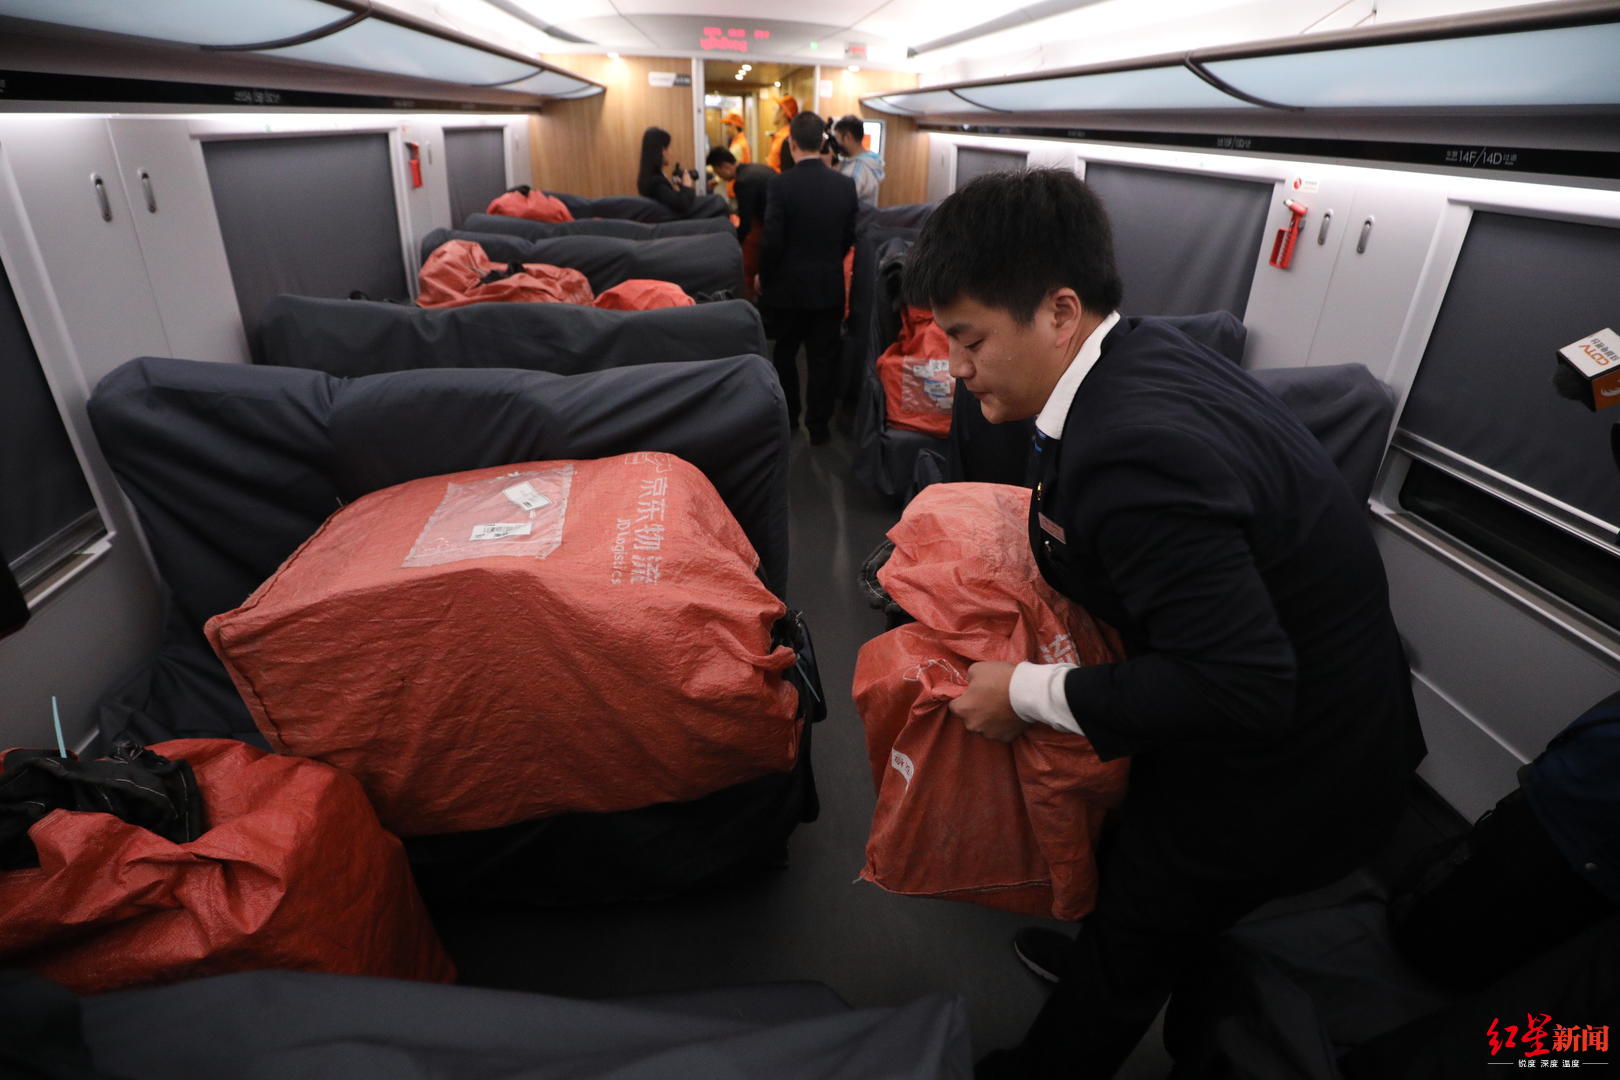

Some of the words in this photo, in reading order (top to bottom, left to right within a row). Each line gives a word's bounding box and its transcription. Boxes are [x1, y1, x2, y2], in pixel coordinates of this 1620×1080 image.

[1577, 344, 1611, 367] CDTV
[630, 477, 668, 585] 京东物流
